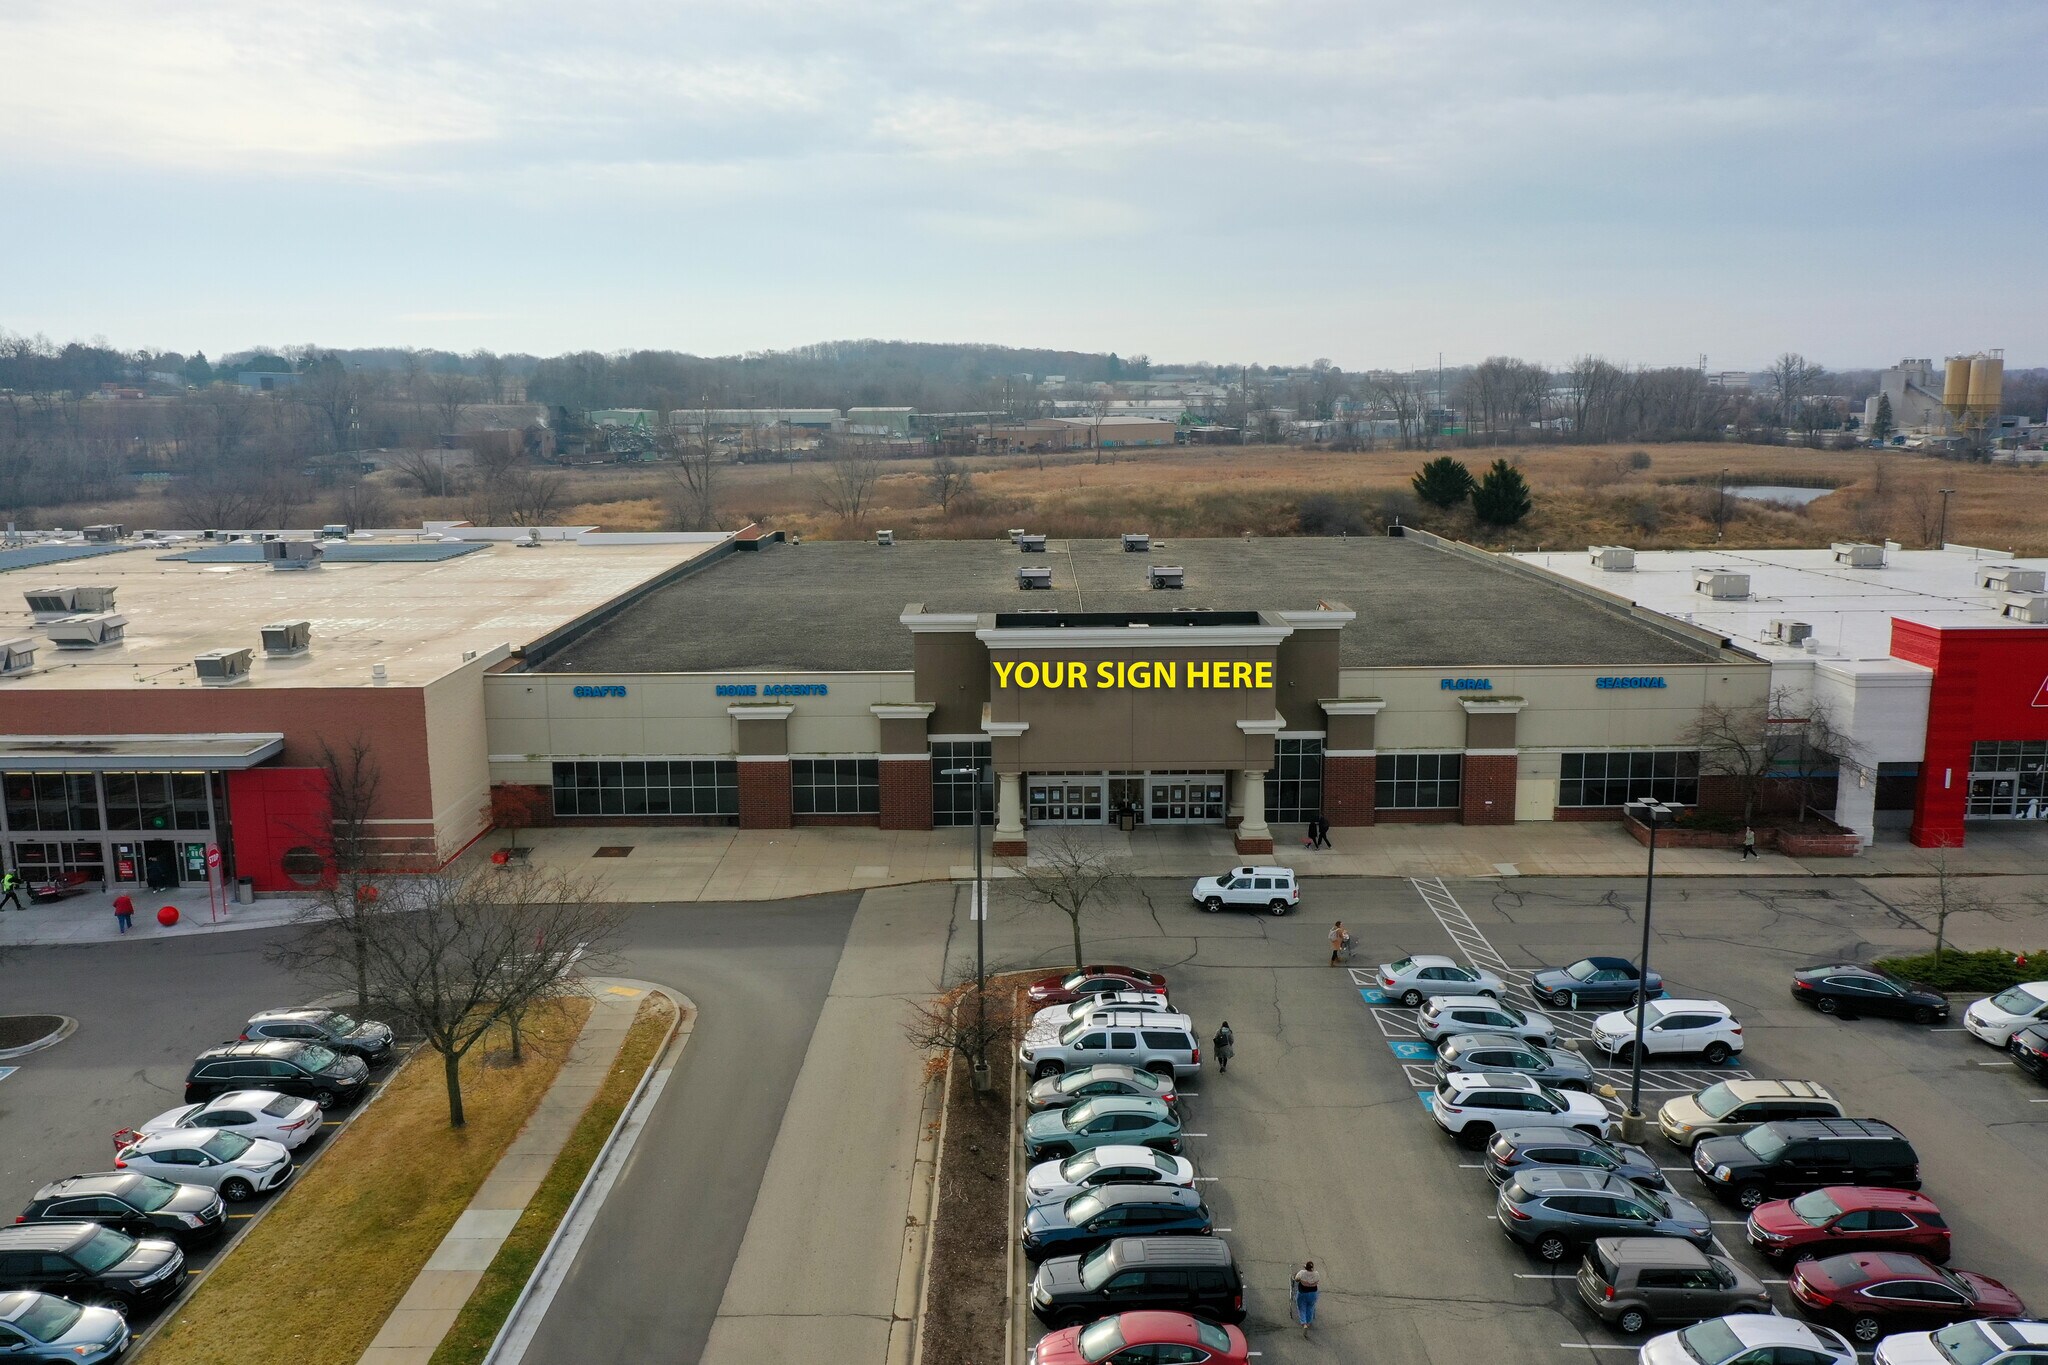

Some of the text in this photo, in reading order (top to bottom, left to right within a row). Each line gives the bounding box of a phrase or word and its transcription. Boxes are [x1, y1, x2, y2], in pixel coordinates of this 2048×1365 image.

[1440, 678, 1493, 690] FLORAL
[1596, 676, 1668, 689] SEASONAL
[573, 685, 627, 698] CRAFTS
[715, 684, 828, 697] HOME ACCENTS
[208, 853, 220, 865] STOP
